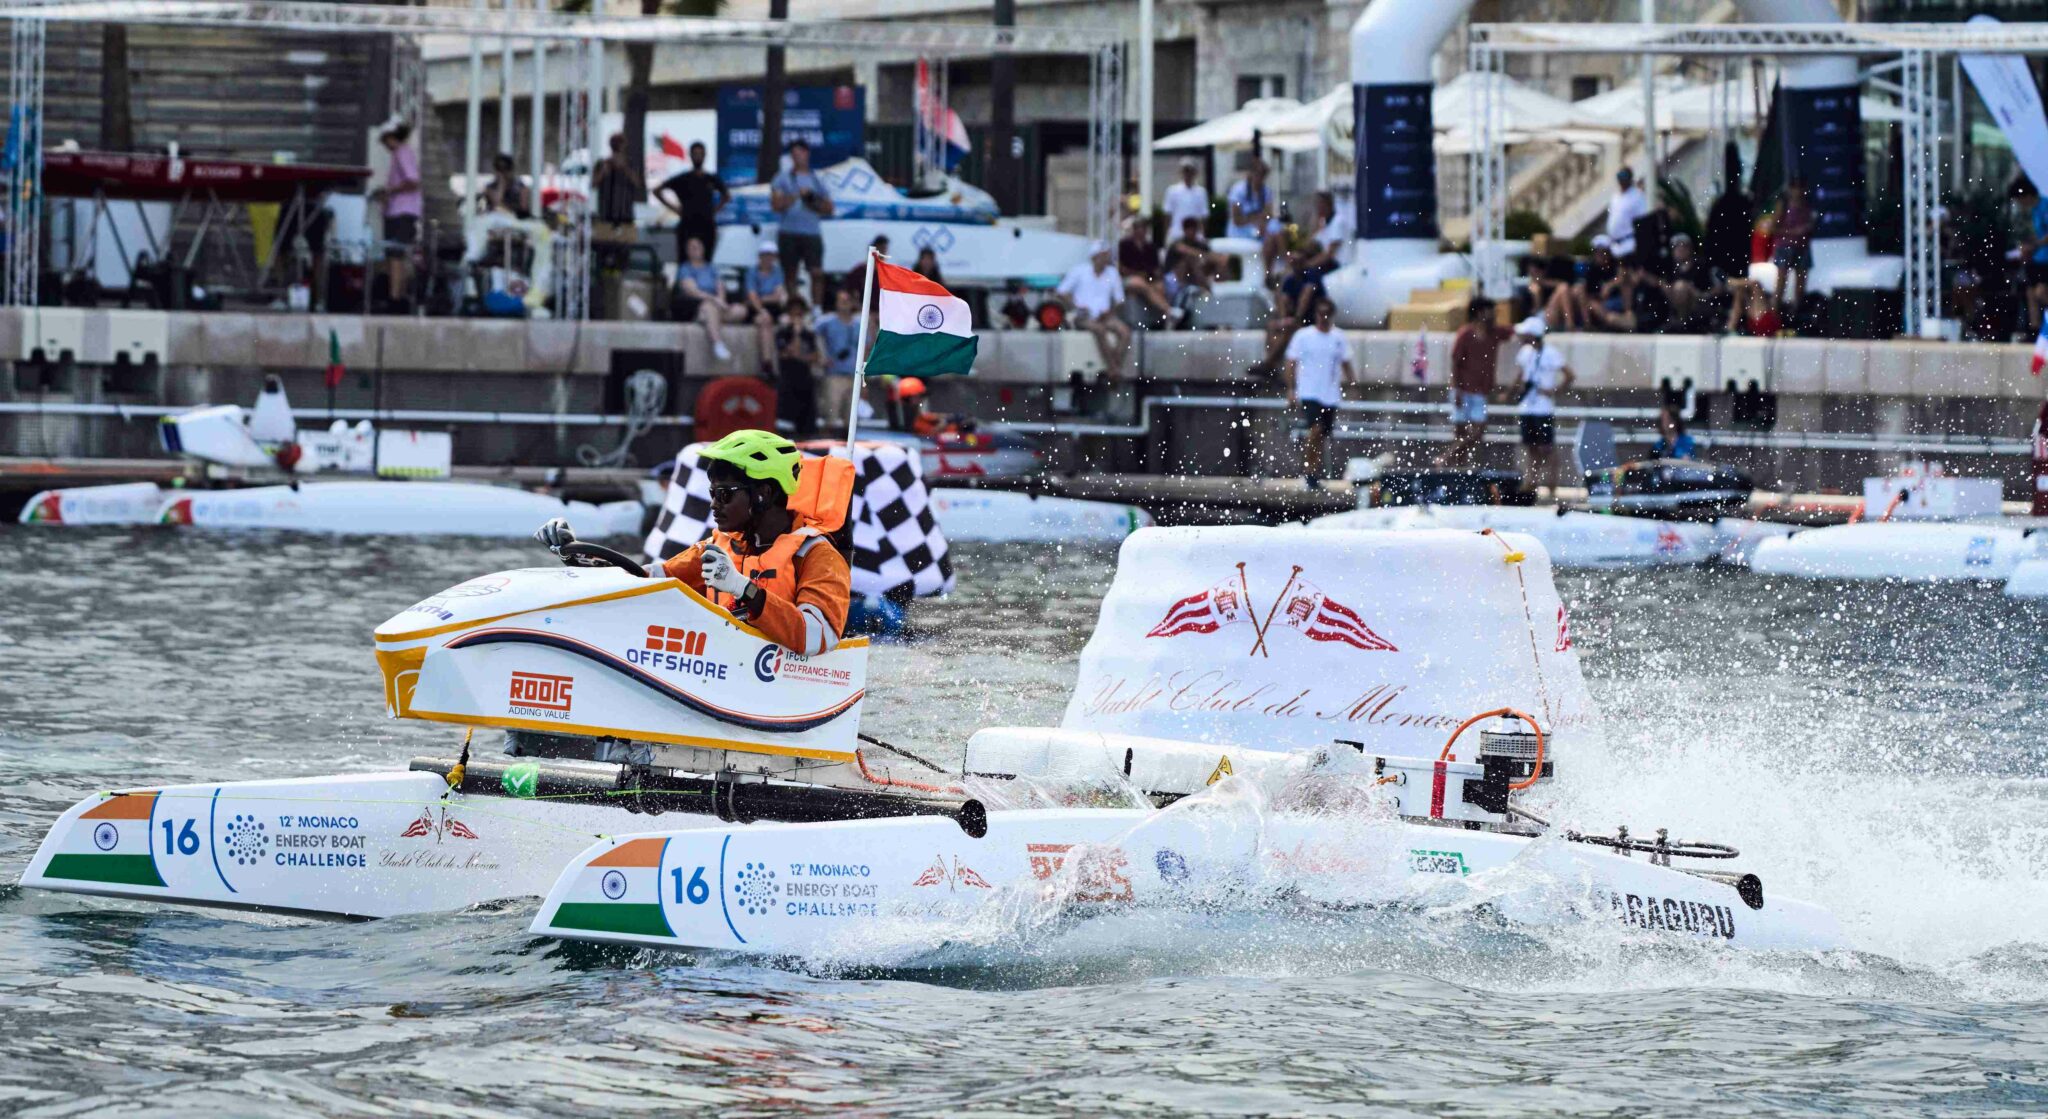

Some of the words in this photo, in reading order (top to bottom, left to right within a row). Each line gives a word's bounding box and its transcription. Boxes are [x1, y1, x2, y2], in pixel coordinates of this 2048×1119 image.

[646, 625, 707, 656] SBM
[626, 648, 728, 680] OFFSHORE
[784, 663, 797, 673] CCI
[797, 666, 851, 680] FRANCE-INDE
[510, 671, 573, 711] ROOTS
[1086, 674, 1163, 717] Yacht
[1168, 669, 1278, 712] Club
[1263, 689, 1311, 717] de
[508, 706, 542, 717] ADDING
[544, 709, 570, 719] VALUE
[298, 816, 358, 828] MONACO
[162, 819, 200, 855] 16
[276, 834, 327, 848] ENERGY
[331, 836, 366, 848] BOAT
[275, 853, 366, 867] CHALLENGE
[413, 850, 446, 868] Club
[809, 864, 870, 877] MONACO
[671, 866, 710, 905] 16
[786, 883, 838, 897] ENERGY
[843, 884, 878, 897] BOAT
